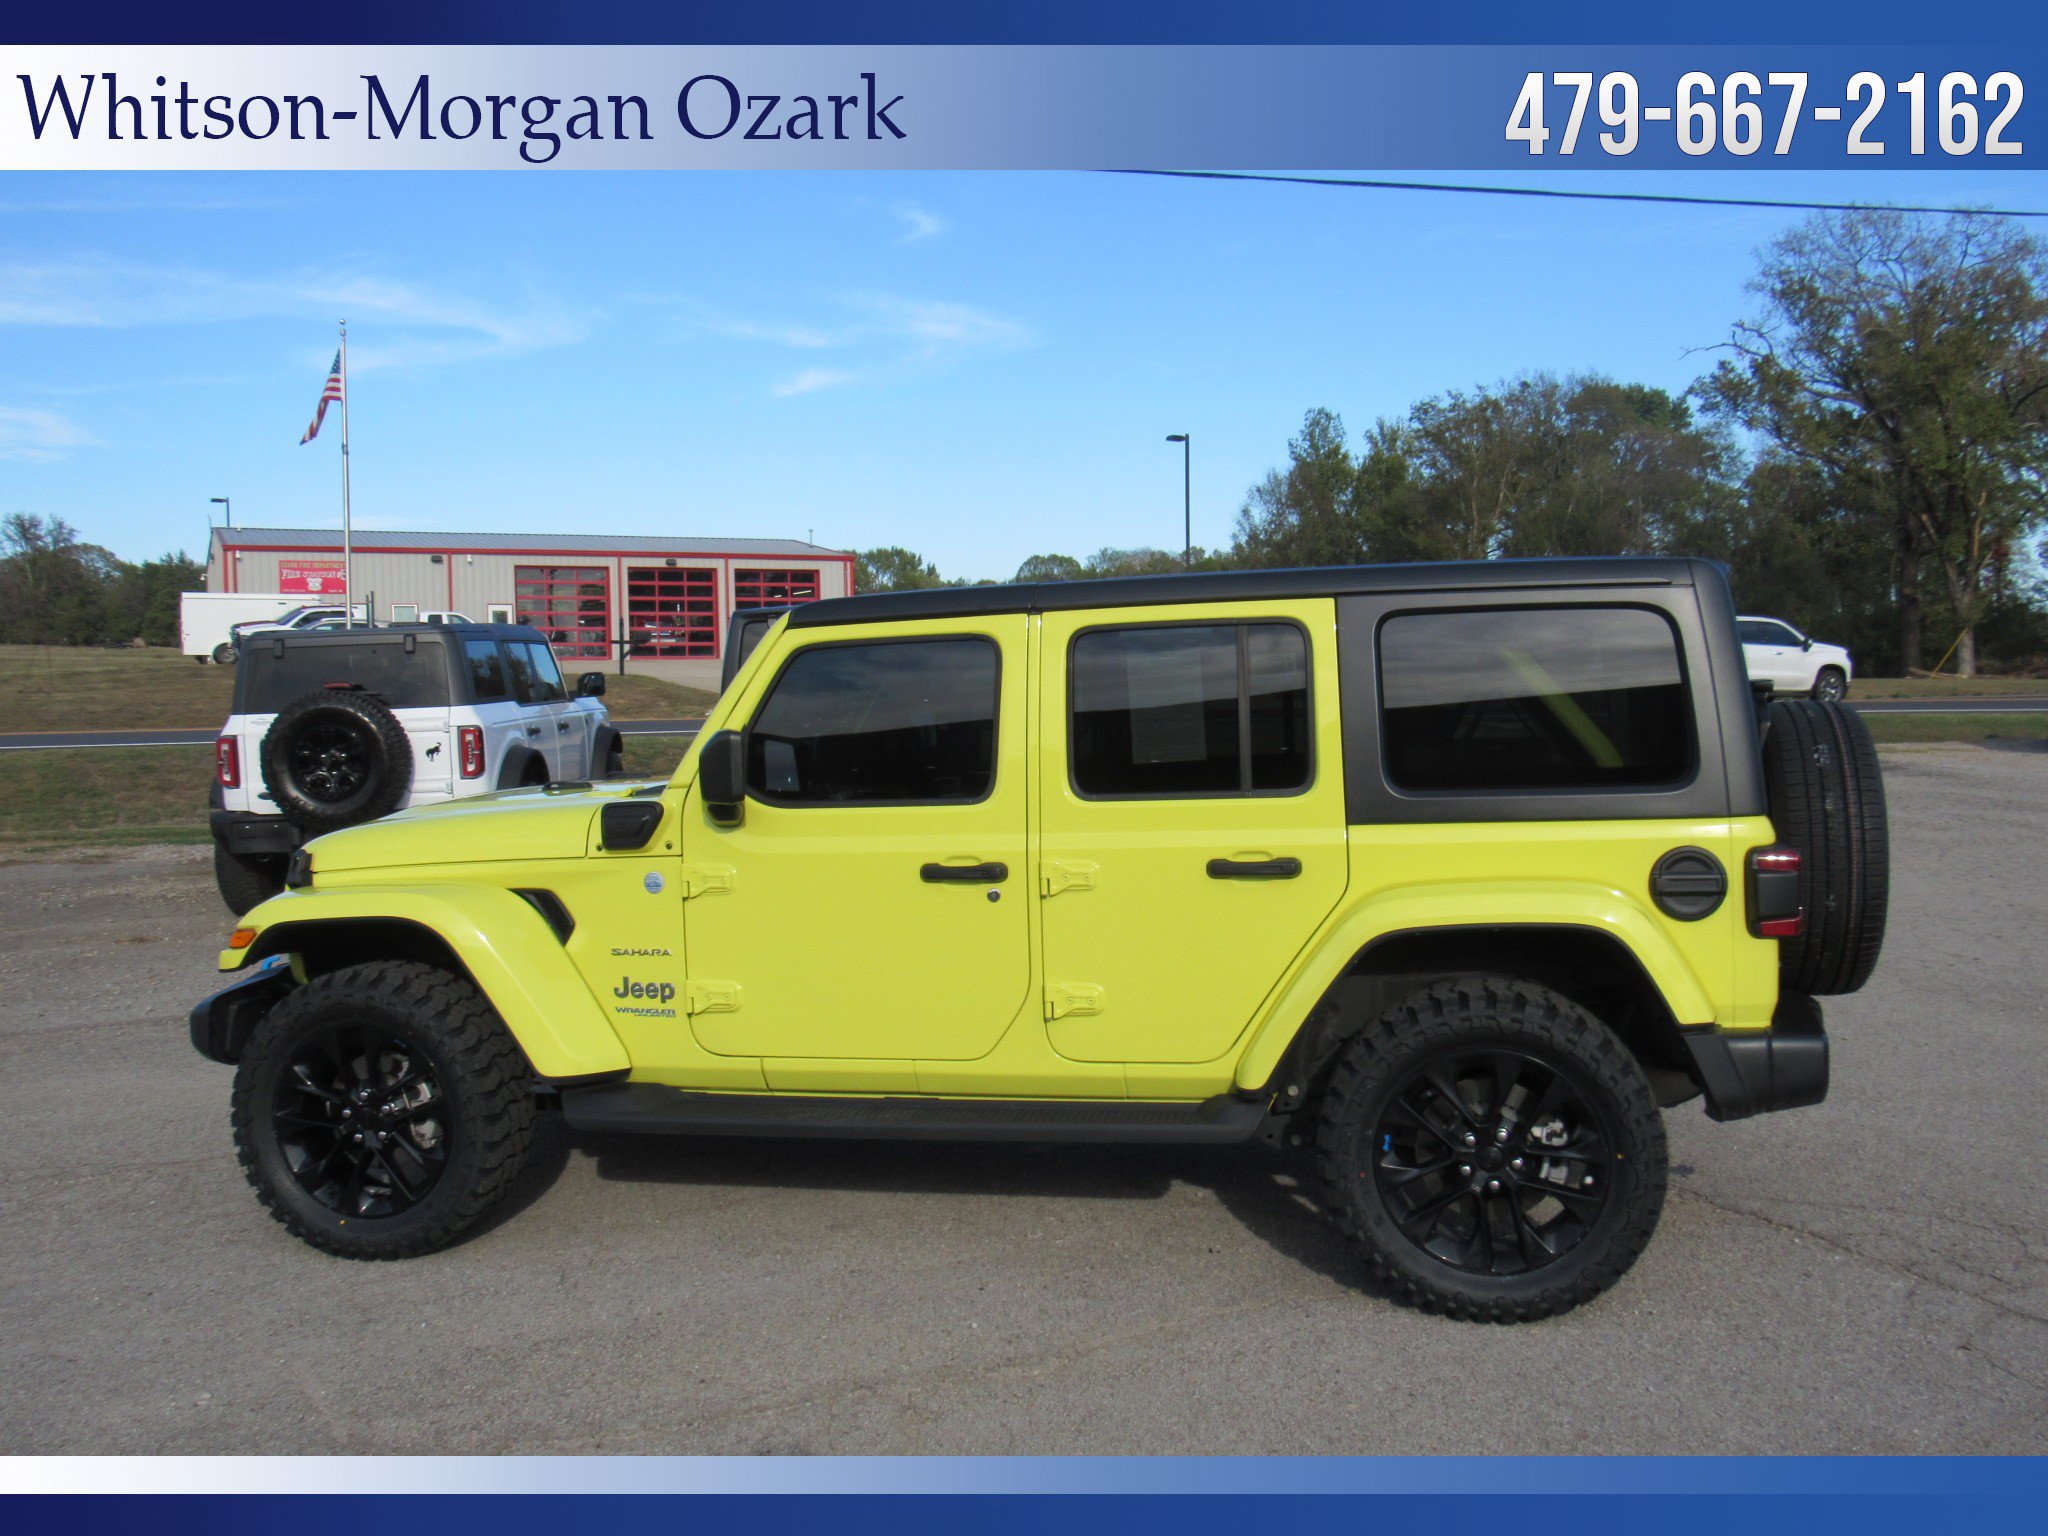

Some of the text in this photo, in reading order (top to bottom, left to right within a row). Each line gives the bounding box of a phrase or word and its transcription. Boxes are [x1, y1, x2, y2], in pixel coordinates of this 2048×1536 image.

[611, 948, 672, 956] SAHARA
[613, 976, 675, 1003] Jeep
[615, 1006, 676, 1015] WRANGLER
